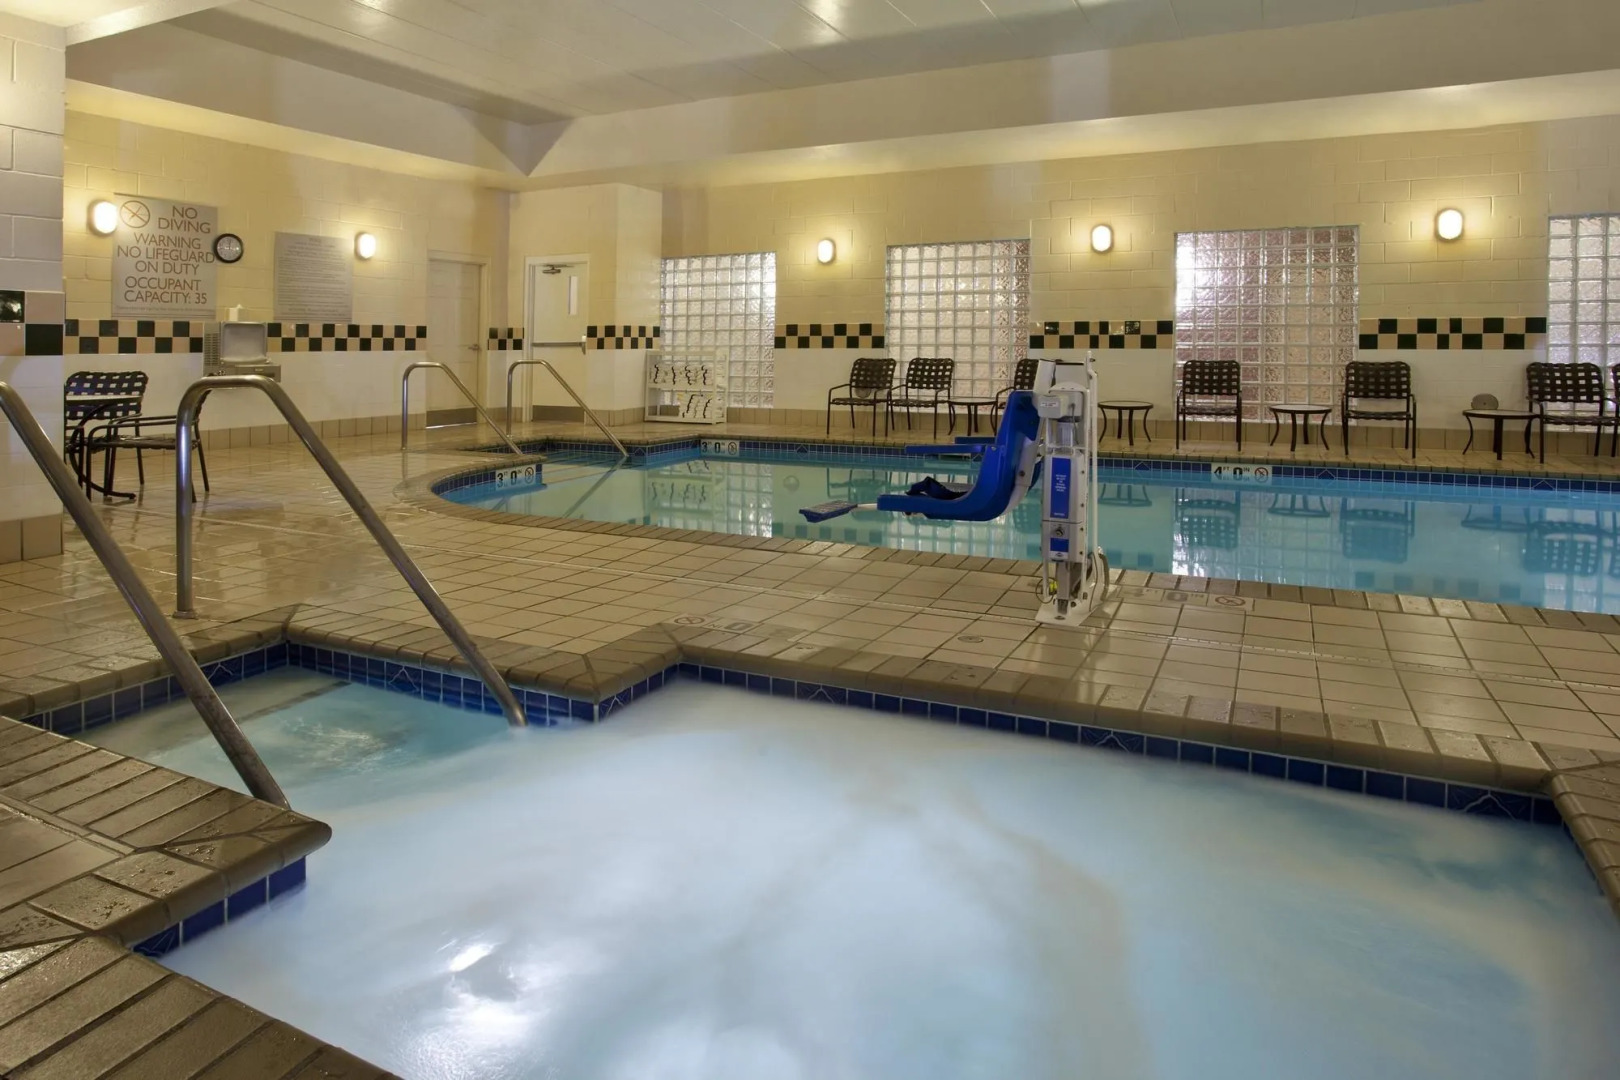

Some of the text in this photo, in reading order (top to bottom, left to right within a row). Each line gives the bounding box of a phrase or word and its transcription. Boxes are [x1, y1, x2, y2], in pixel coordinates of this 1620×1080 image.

[172, 205, 198, 220] NO
[158, 217, 211, 233] DIVING
[134, 233, 201, 249] WARNING
[117, 245, 215, 263] NO LIFEGUARD
[135, 260, 200, 275] ON DUTY
[125, 276, 202, 291] OCCUPANT
[124, 290, 207, 305] CAPACITY: 35
